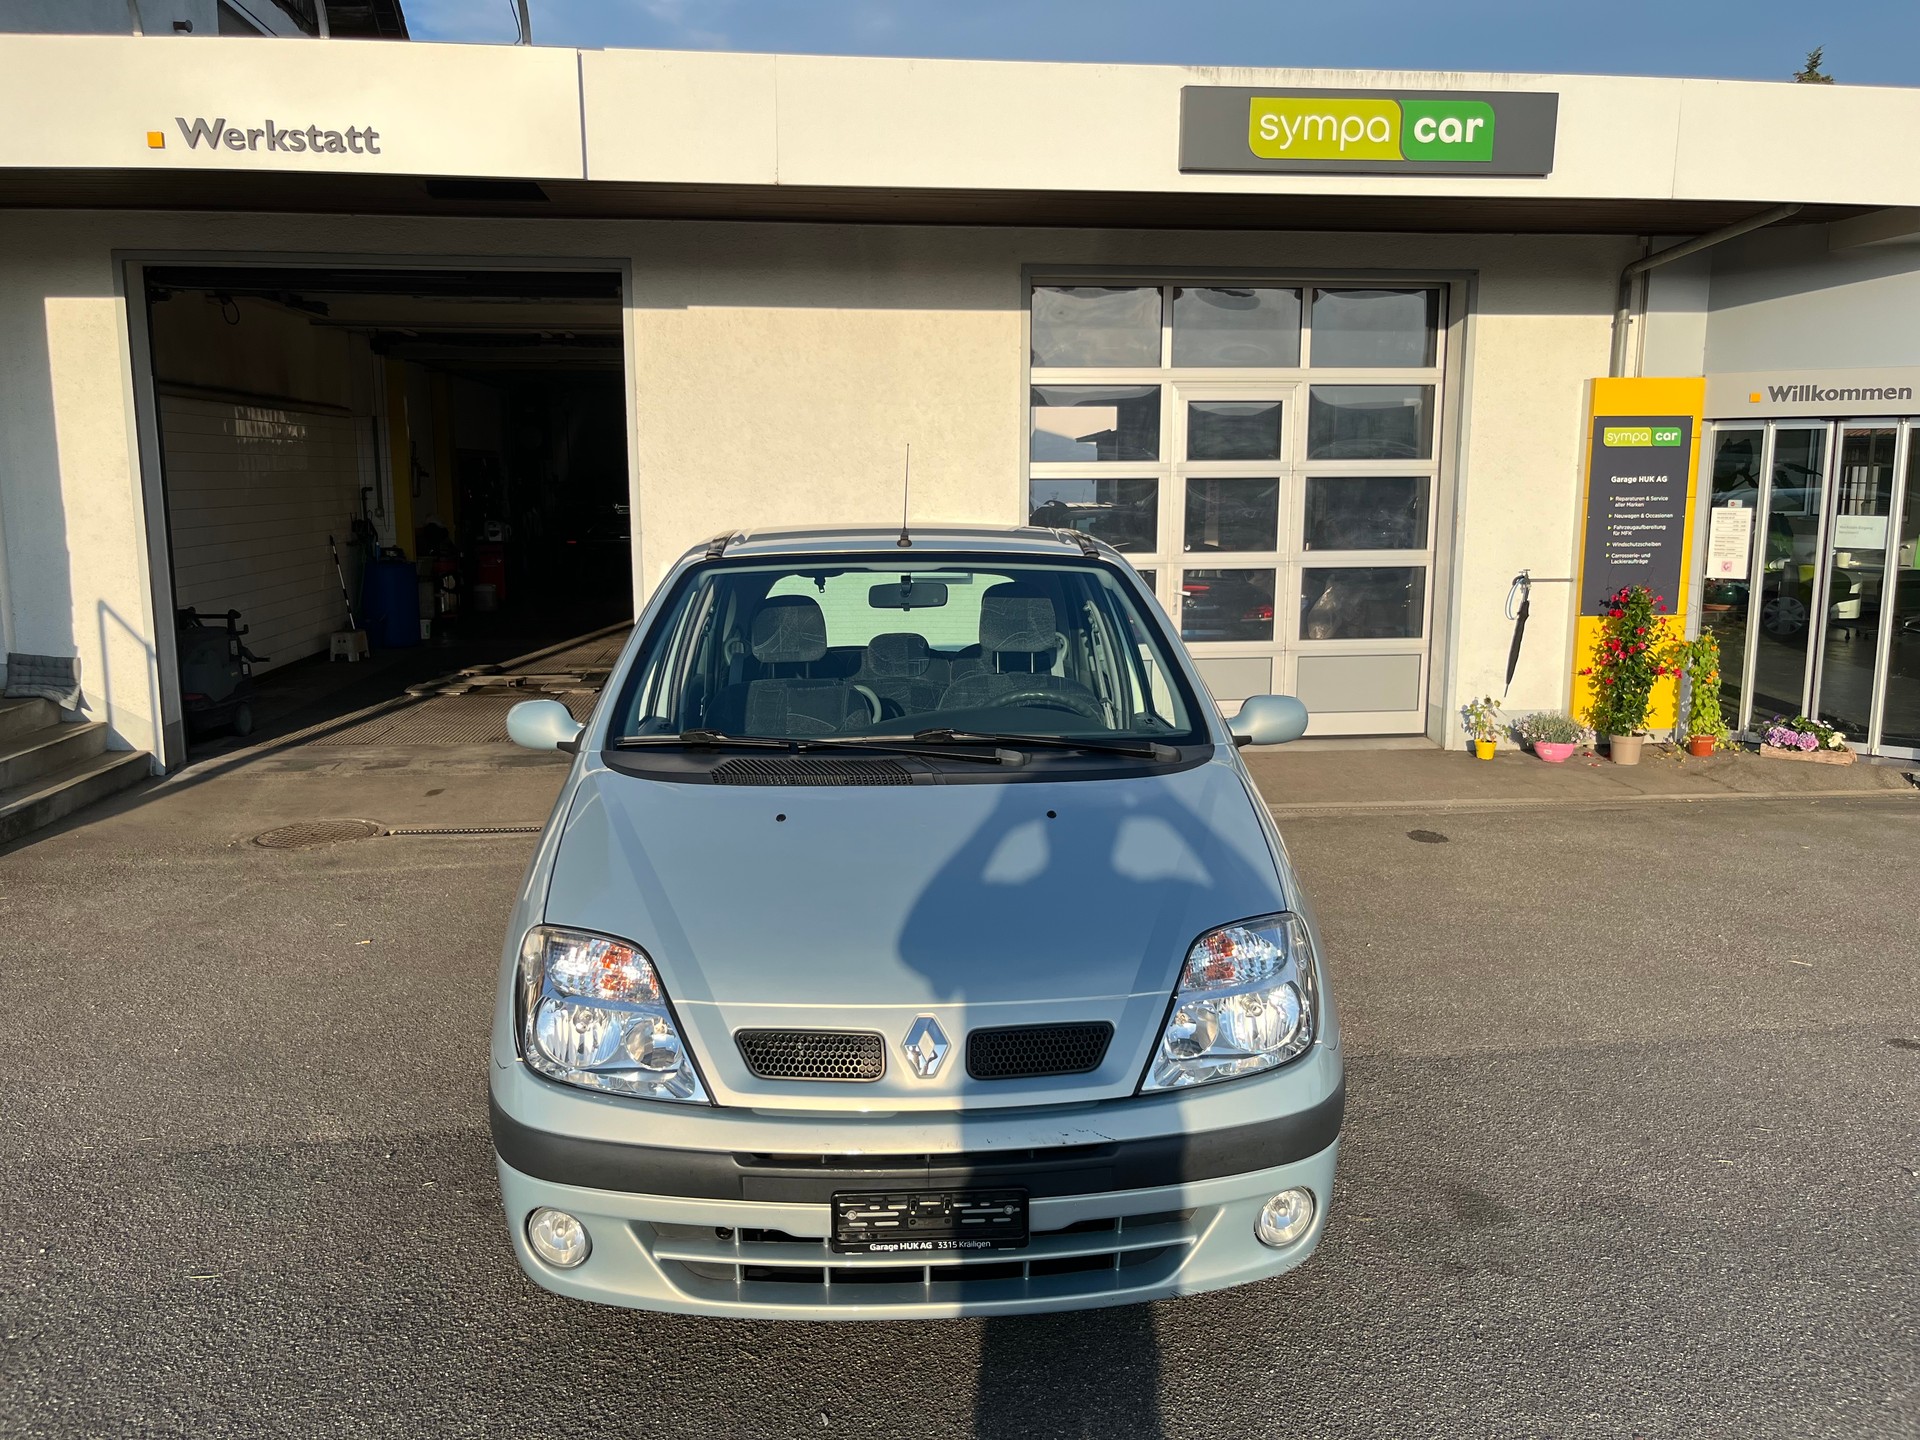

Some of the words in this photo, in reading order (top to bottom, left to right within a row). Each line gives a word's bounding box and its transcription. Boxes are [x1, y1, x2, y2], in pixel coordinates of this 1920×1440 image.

[175, 117, 381, 154] Werkstatt
[1259, 112, 1390, 151] sympa
[1413, 116, 1484, 144] car
[1768, 385, 1912, 402] Willkommen
[1606, 432, 1649, 443] sympa
[1655, 431, 1678, 441] car
[1611, 476, 1637, 484] Garage
[869, 1243, 898, 1252] Garage
[900, 1242, 919, 1250] HUK
[920, 1242, 933, 1250] AG
[938, 1241, 958, 1249] 3315
[959, 1240, 991, 1249] Kräiligen
